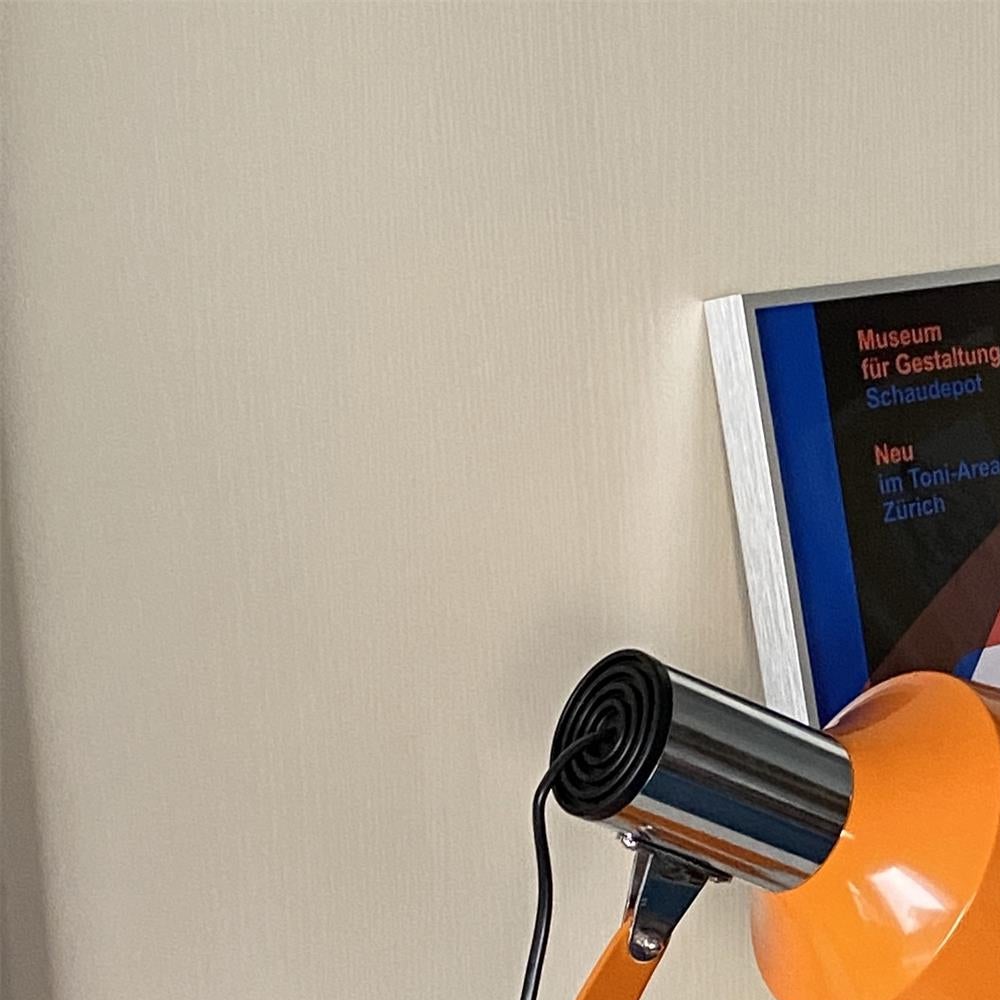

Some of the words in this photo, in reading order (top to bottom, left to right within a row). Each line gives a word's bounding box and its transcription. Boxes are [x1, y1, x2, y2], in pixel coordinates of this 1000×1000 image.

[857, 325, 942, 351] Museum
[861, 357, 890, 380] für
[866, 375, 983, 409] Schaudepot
[874, 443, 914, 466] Neu
[878, 473, 903, 495] im
[883, 497, 946, 523] Zürich
